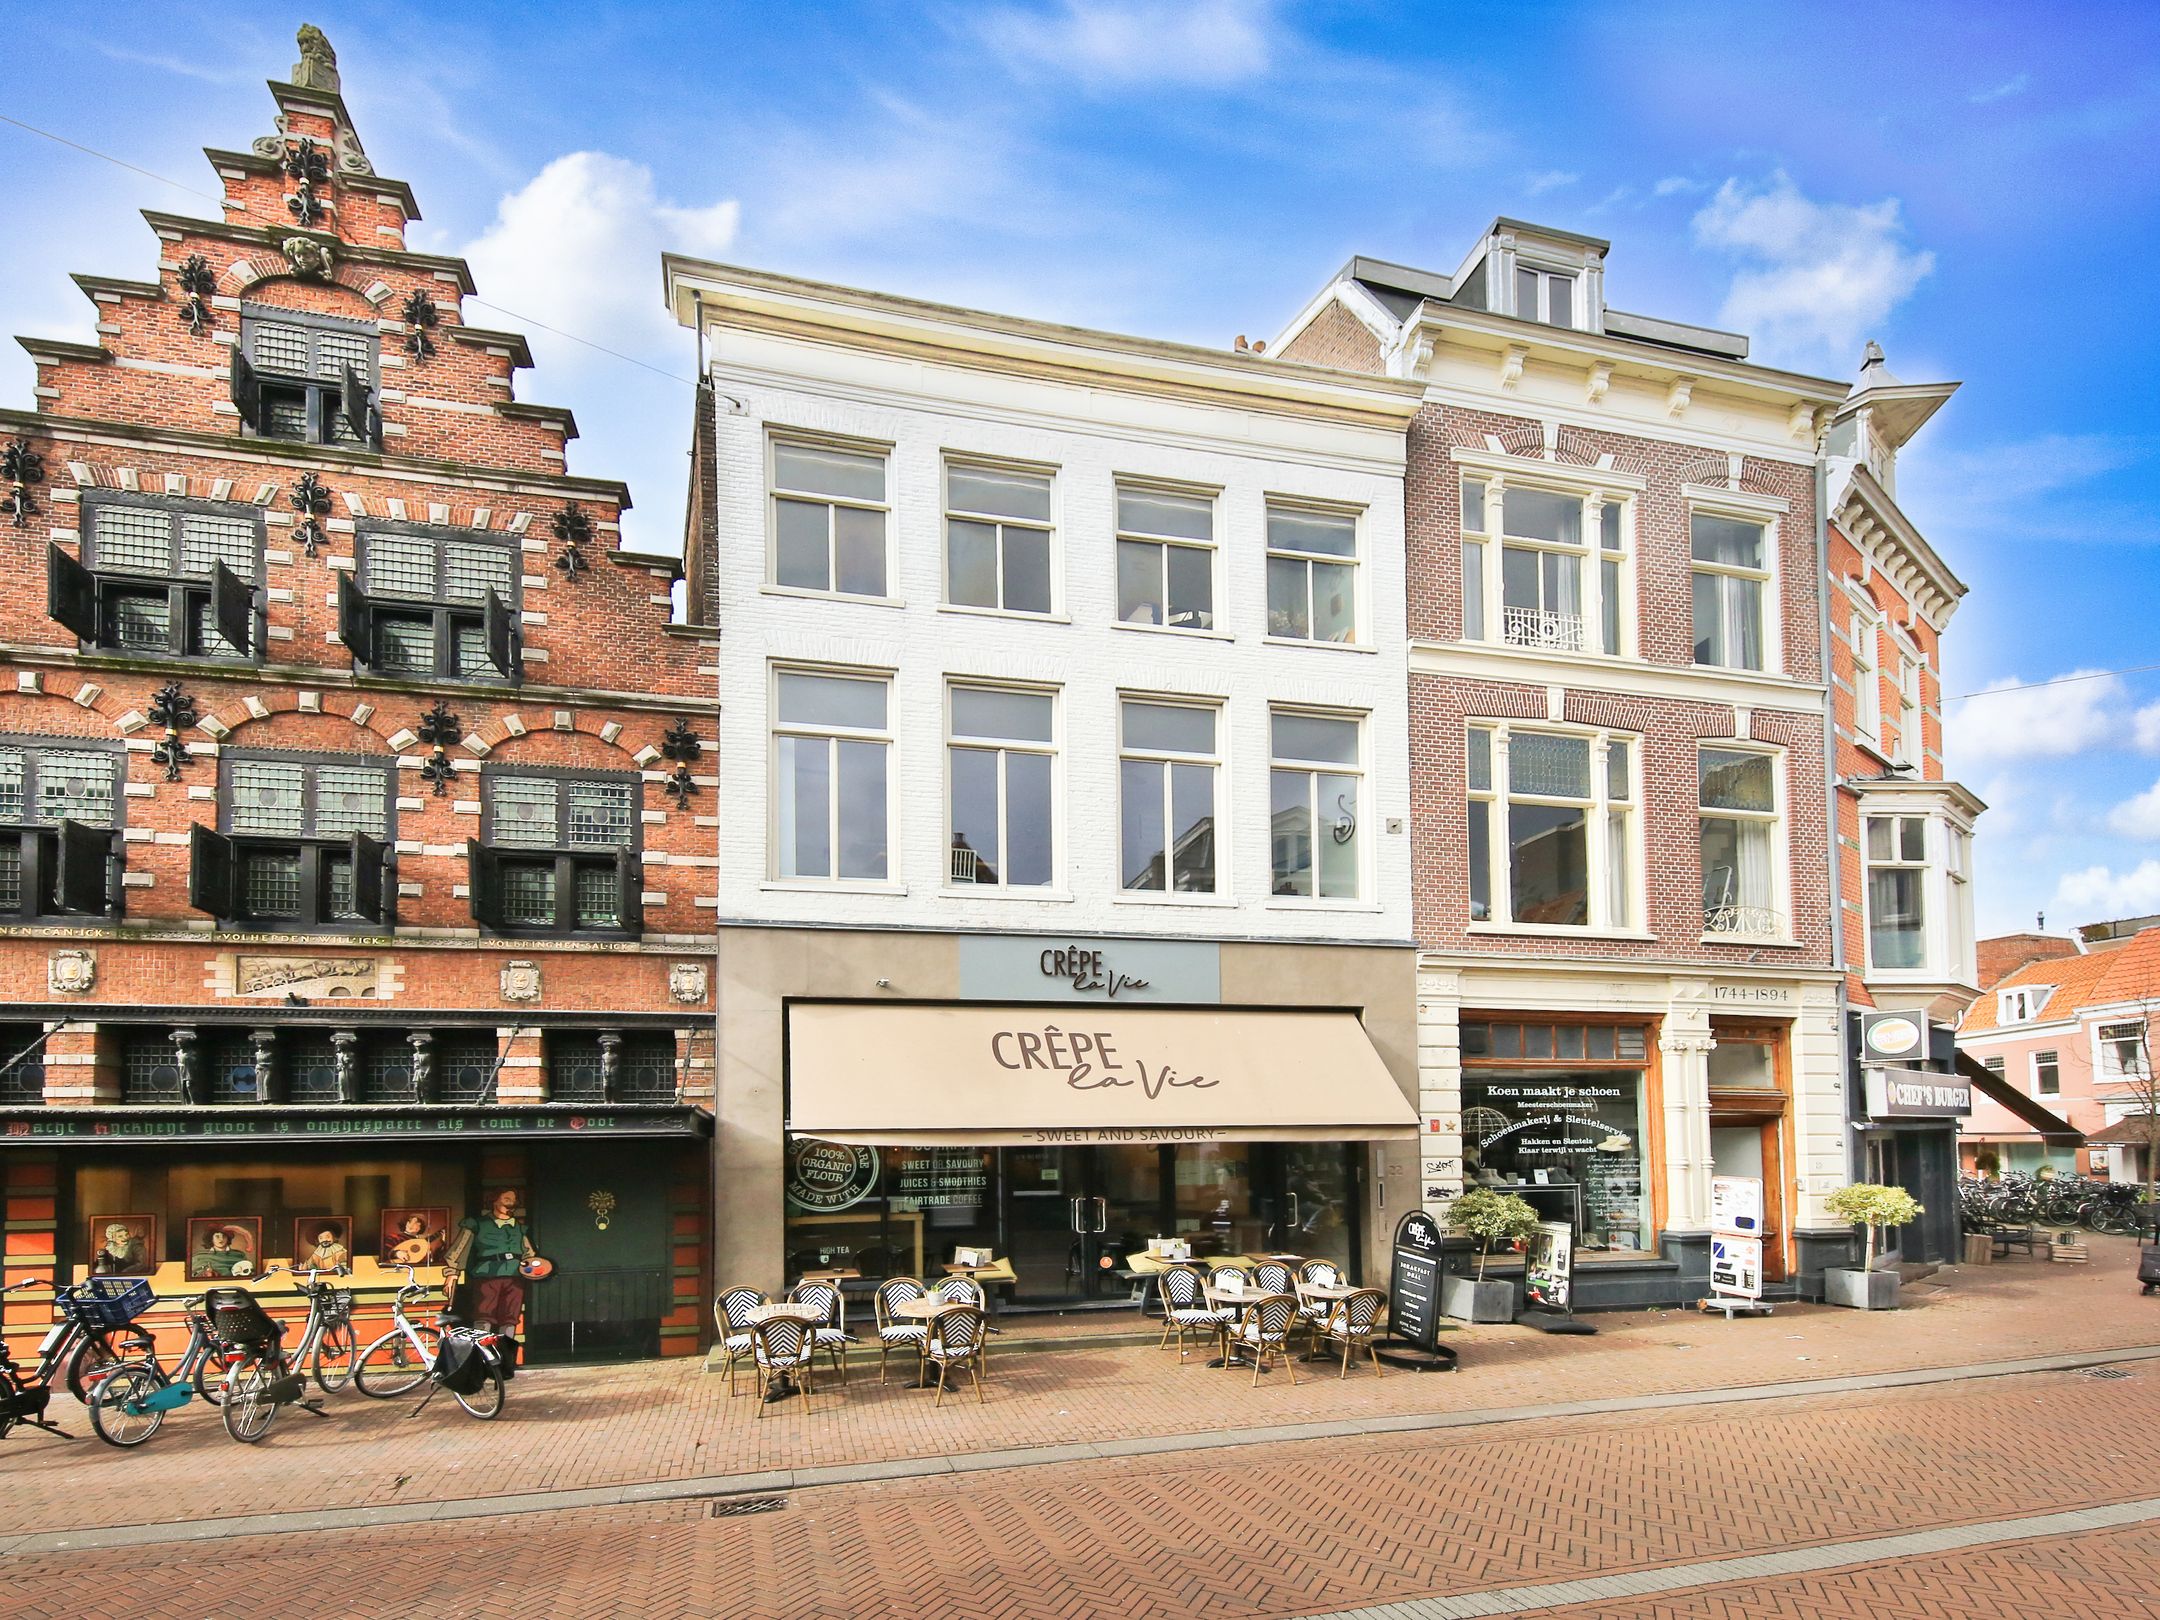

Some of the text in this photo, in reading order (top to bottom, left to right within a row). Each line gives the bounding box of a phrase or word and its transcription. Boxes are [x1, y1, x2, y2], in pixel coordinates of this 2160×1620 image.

[1040, 944, 1103, 977] CRÊPE
[1073, 969, 1150, 998] la Vie
[1715, 986, 1788, 1001] 1744-1894
[991, 1024, 1123, 1070] CRÊPE
[1067, 1059, 1220, 1100] la Vie
[1487, 1085, 1621, 1098] Koen maakt je schoen
[1934, 1086, 1970, 1107] BURGER
[1037, 1127, 1216, 1142] SWEET AND SAVOURY
[1480, 1115, 1551, 1148] Schoenmakerij
[1553, 1114, 1562, 1123] &
[814, 1147, 845, 1161] 100%
[802, 1157, 852, 1173] ORGANIC
[901, 1160, 930, 1170] SWEET
[945, 1158, 984, 1169] SAVOURY
[805, 1169, 844, 1183] FLOUR
[899, 1178, 928, 1188] JUICES
[938, 1176, 987, 1187] SMOOTHIES
[788, 1180, 861, 1204] MADE WITH
[904, 1195, 951, 1206] FAIRTRADE
[836, 1246, 850, 1254] TEA
